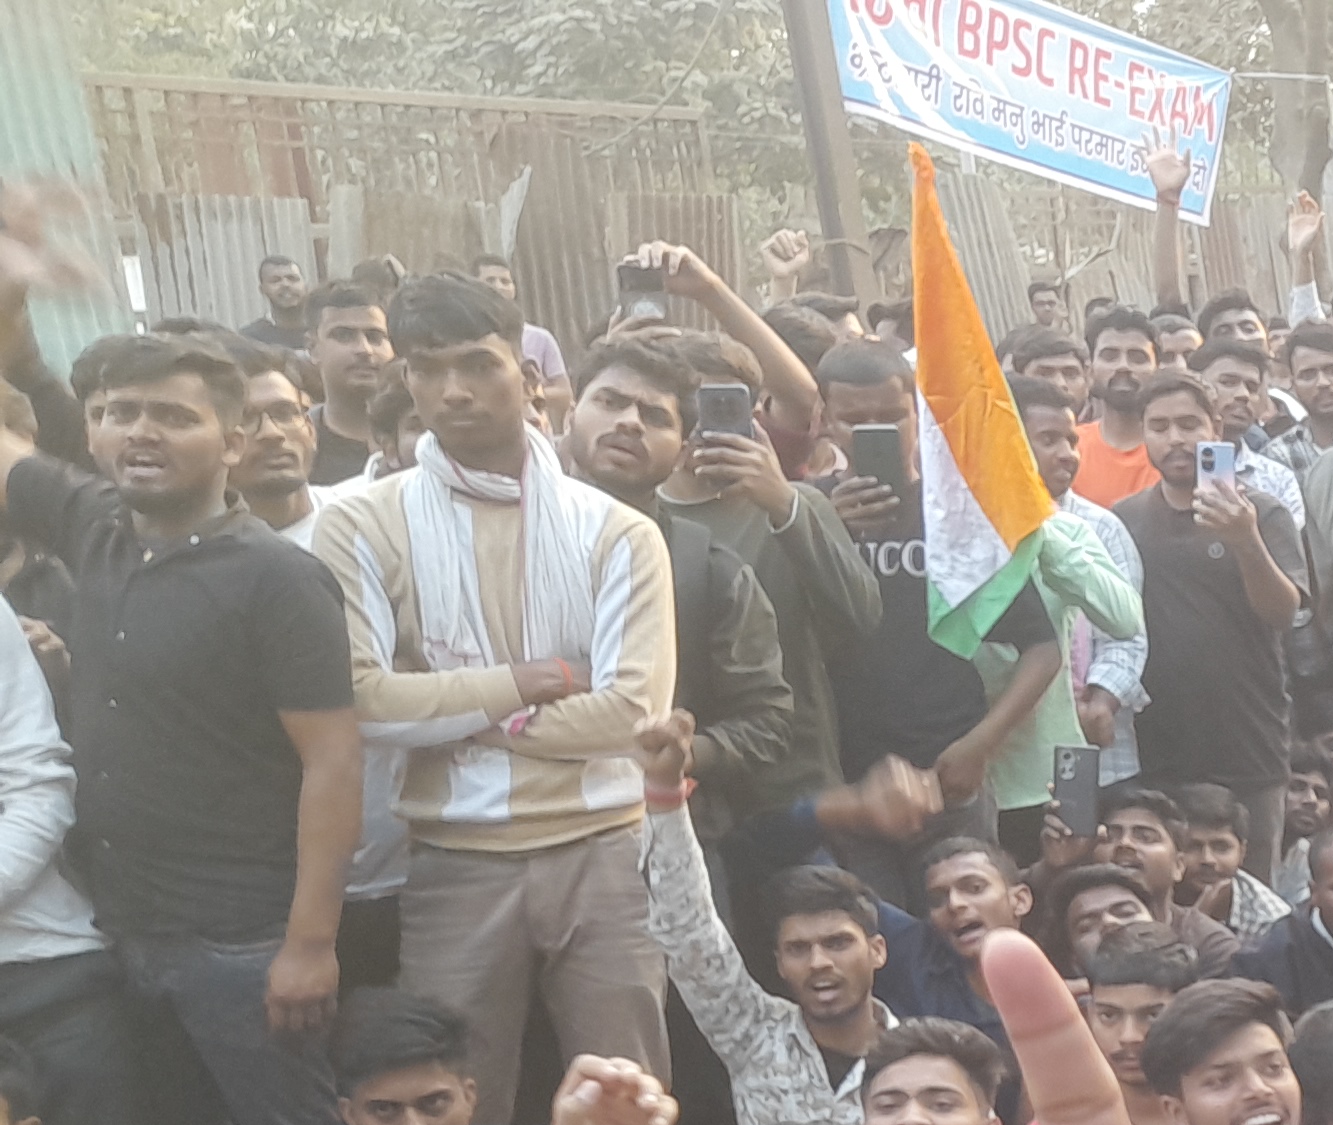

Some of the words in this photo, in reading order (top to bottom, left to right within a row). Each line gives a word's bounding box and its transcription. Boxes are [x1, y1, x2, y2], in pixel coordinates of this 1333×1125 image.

[957, 0, 1056, 87] BPSC
[1067, 37, 1215, 142] RE-EXAM
[1031, 110, 1068, 148] भाई
[1070, 122, 1127, 166] परमार
